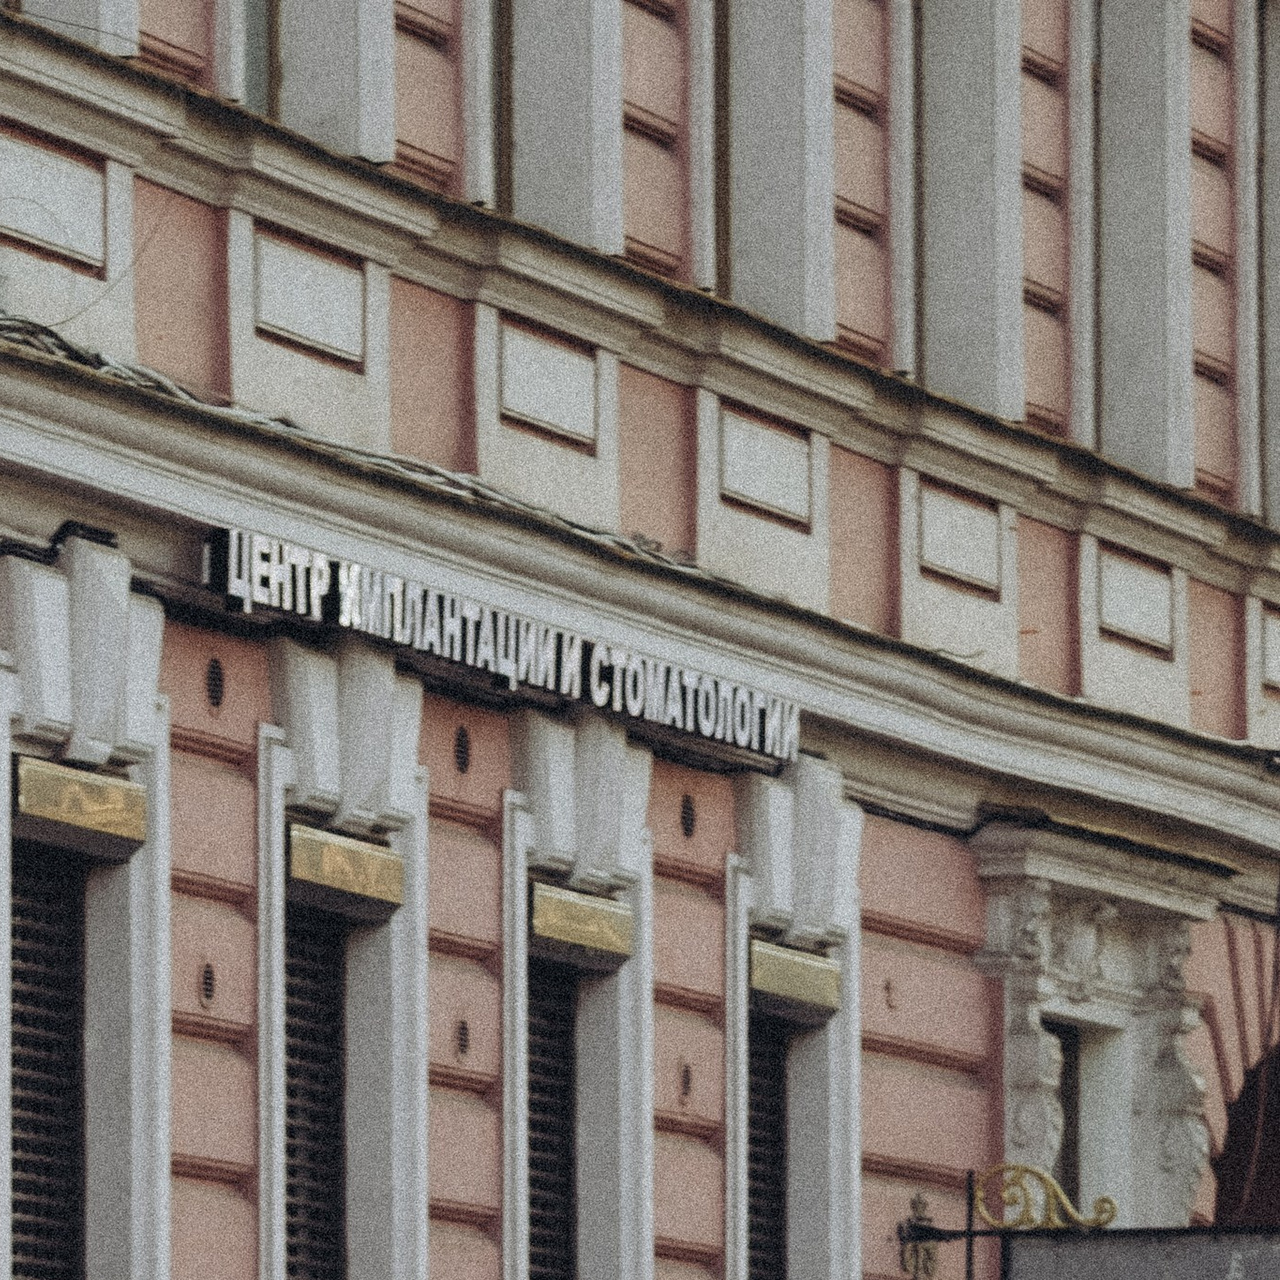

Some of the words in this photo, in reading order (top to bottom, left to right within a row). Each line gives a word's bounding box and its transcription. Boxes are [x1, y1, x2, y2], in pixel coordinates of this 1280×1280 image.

[228, 527, 330, 621] ЦЕНТР
[559, 633, 582, 699] И
[589, 640, 801, 763] СТОМАТОЛОГИИ
